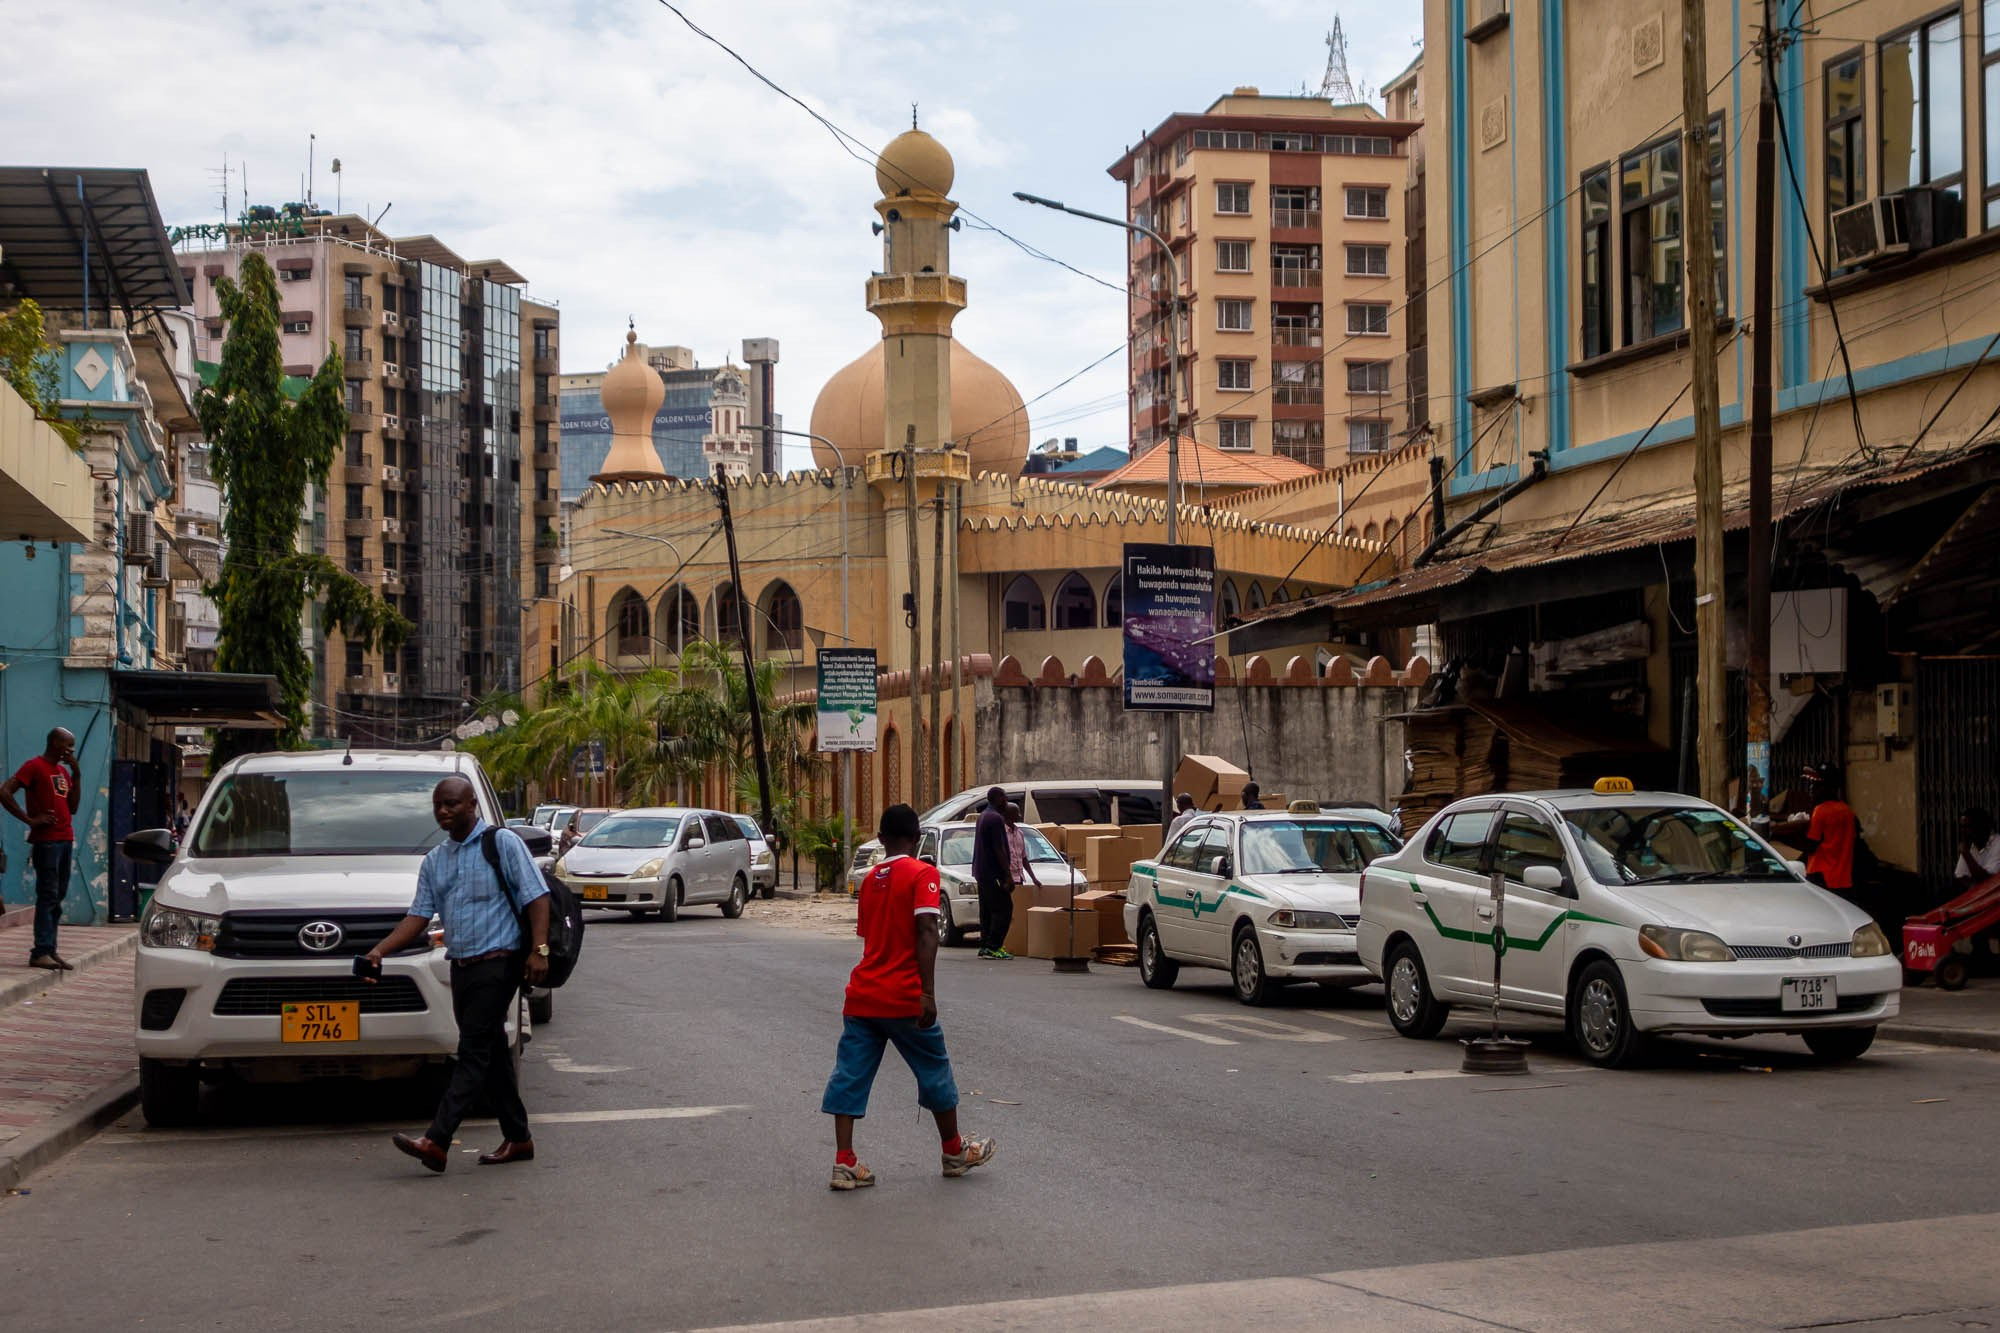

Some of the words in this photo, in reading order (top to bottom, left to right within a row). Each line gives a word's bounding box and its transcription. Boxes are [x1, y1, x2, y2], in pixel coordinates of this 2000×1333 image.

[238, 215, 305, 237] TOWER
[581, 420, 600, 428] TULIP
[655, 415, 683, 424] GOLDEN
[684, 413, 704, 422] TULIP
[1137, 565, 1161, 575] Hakika
[1163, 566, 1194, 578] Mwenyezi
[1139, 579, 1179, 591] huwapenda
[1165, 593, 1201, 605] huwapenda
[1135, 691, 1209, 702] www.somaquran.com
[1605, 781, 1628, 790] TAXI
[1792, 979, 1822, 993] T718
[1801, 994, 1823, 1007] DJH
[306, 1004, 336, 1021] STL
[301, 1023, 342, 1040] 7746
